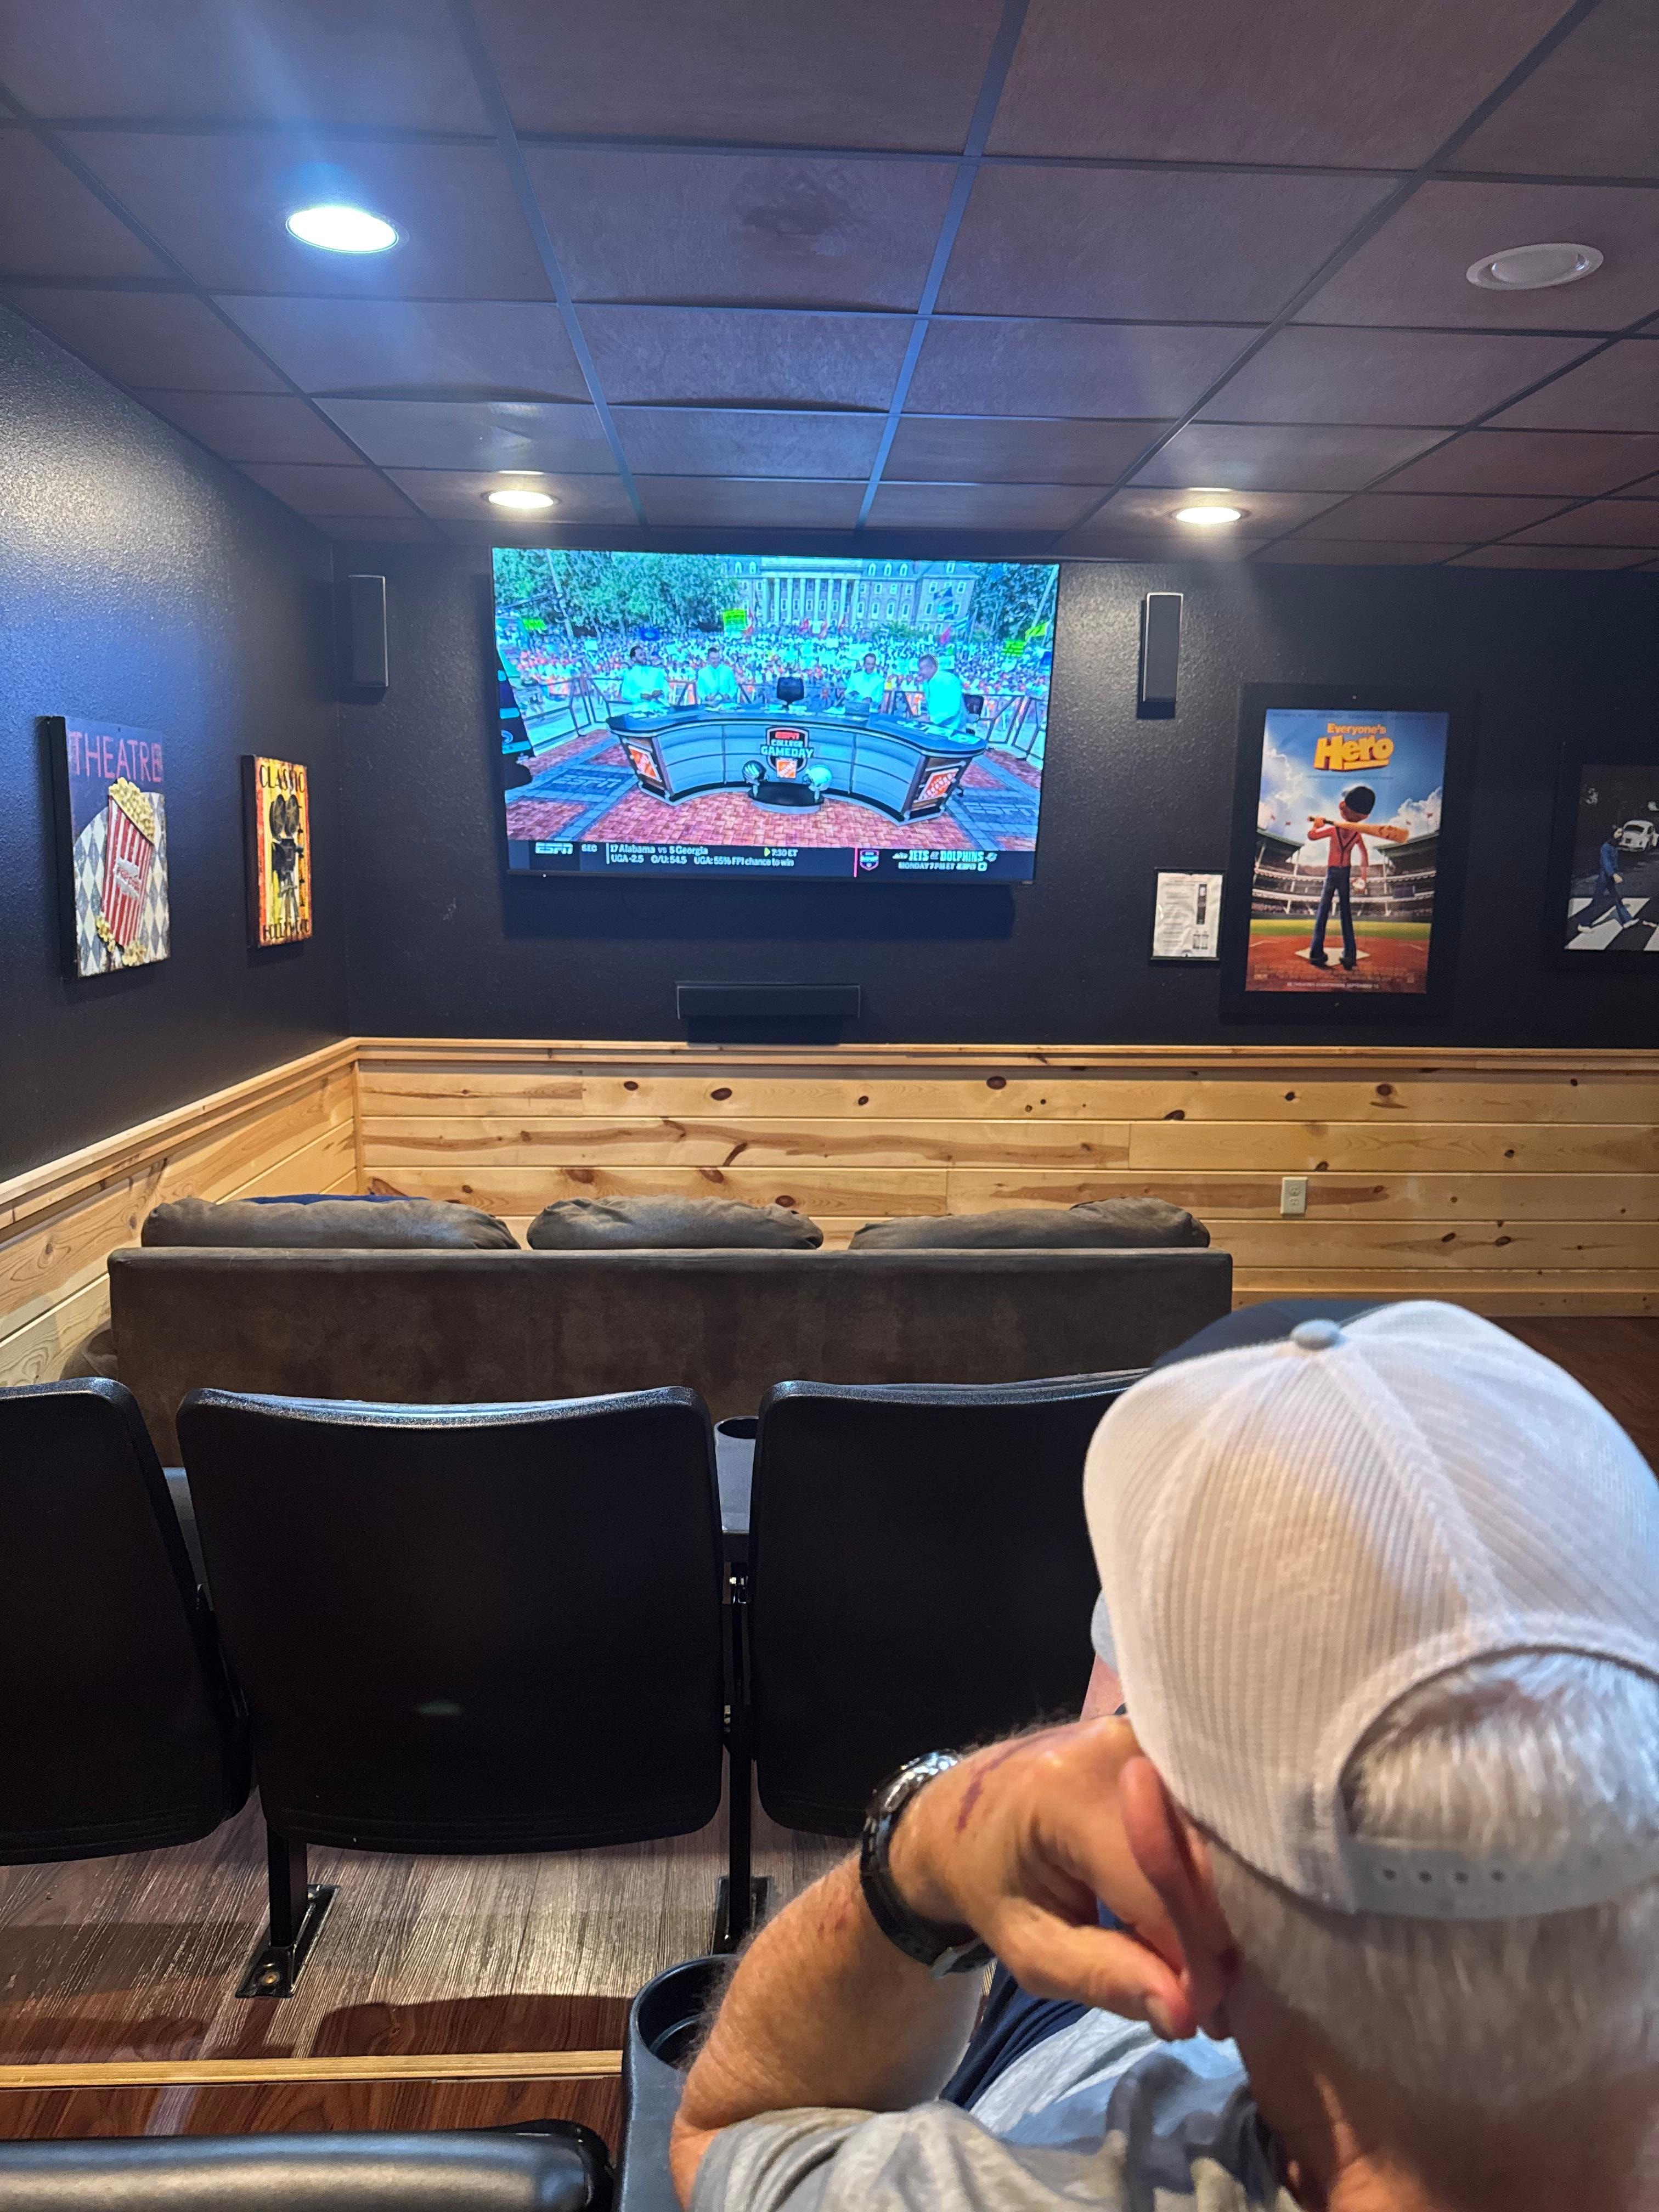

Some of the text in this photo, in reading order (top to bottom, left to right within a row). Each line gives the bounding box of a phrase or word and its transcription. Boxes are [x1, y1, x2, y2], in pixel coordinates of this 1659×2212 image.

[1327, 723, 1386, 735] Everyone's
[69, 731, 163, 782] THEATRE
[760, 746, 814, 758] GAMEDAY
[1313, 735, 1395, 771] Hero
[552, 775, 622, 788] ESPN
[535, 842, 573, 855] ESPN
[619, 844, 656, 854] Alabama
[675, 845, 709, 856] Georgia
[744, 857, 771, 866] chance
[771, 857, 780, 866] to
[780, 858, 794, 867] win
[909, 850, 929, 861] JETS
[940, 850, 984, 862] DOLPHINS
[898, 861, 929, 870] MONDAY
